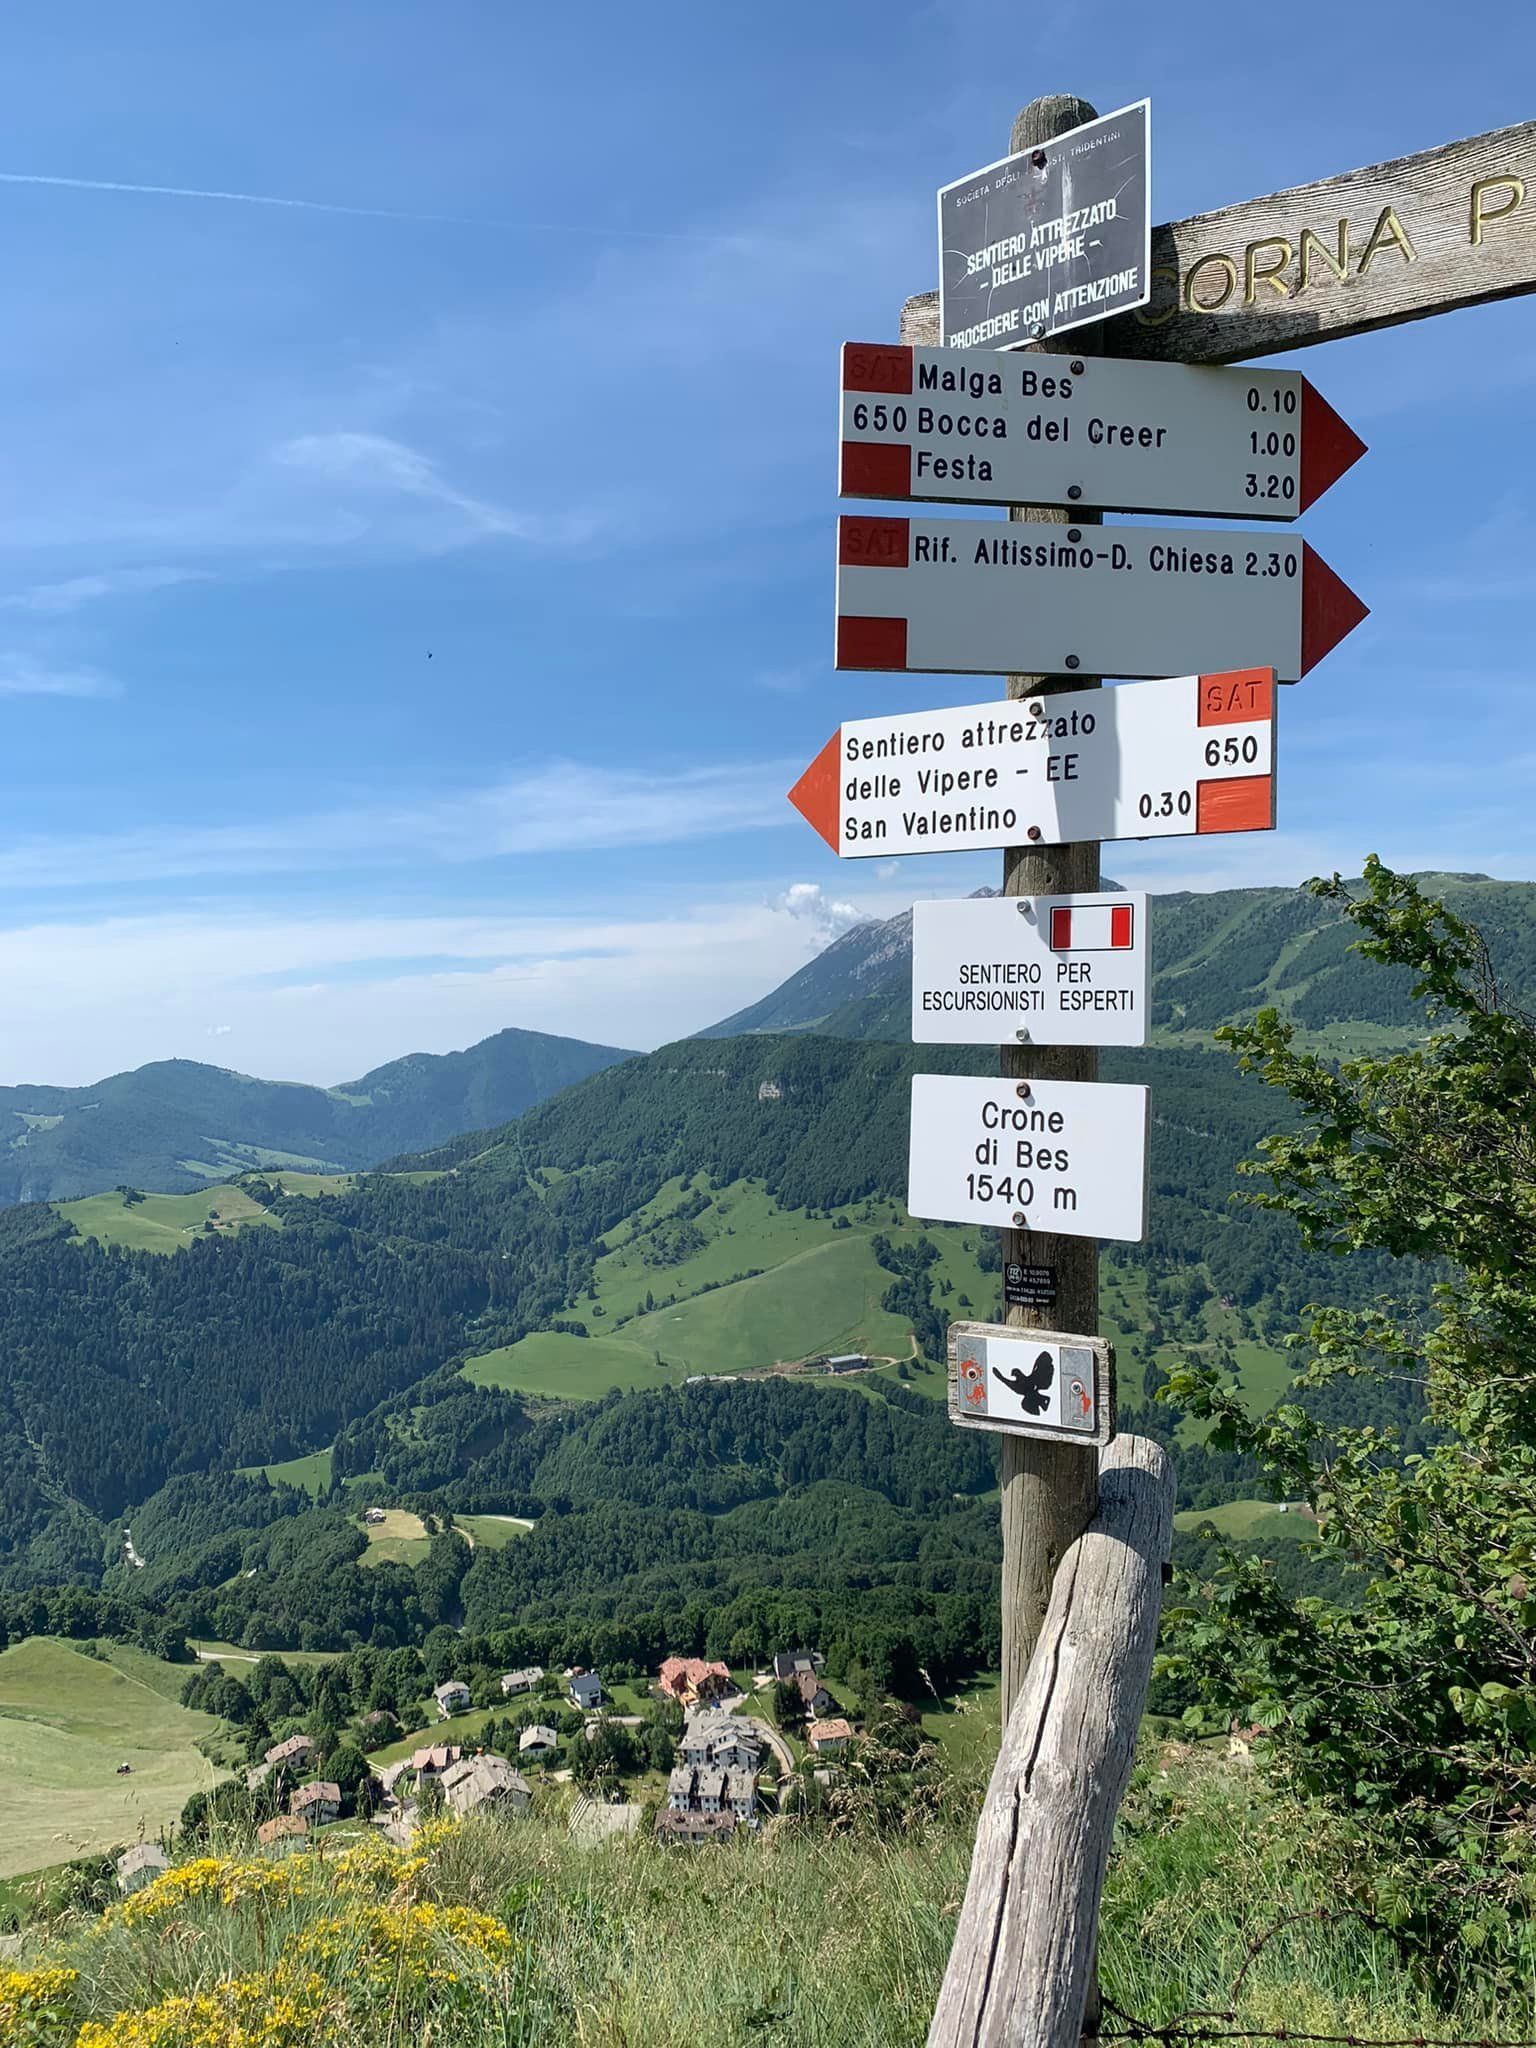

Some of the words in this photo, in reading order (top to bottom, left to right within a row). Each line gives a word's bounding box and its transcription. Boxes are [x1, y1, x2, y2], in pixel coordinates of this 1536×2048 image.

[1070, 129, 1121, 157] TRIDENTINI
[1470, 174, 1526, 247] P
[967, 231, 1026, 275] SENTIERO
[1030, 198, 1117, 248] ATTREZZATO
[992, 254, 1032, 289] DELLE
[1036, 234, 1085, 271] VIPERE
[950, 309, 1019, 349] PROCEDERE
[1023, 299, 1050, 325] CON
[1054, 267, 1138, 315] ATTENZIONE
[850, 353, 904, 383] SAT
[918, 363, 1003, 399] Malga
[1022, 370, 1073, 399] Bes
[1247, 388, 1297, 414] 0.10
[853, 403, 907, 432] 650
[918, 407, 1007, 439] Bocca
[1027, 415, 1068, 442] del
[1087, 418, 1167, 448] Creer
[1250, 431, 1295, 456] 1.00
[917, 451, 993, 481] Festa
[1245, 473, 1295, 499] 3.20
[847, 527, 899, 555] SAT
[915, 535, 957, 563] Rif.
[1150, 545, 1234, 574] Chiesa
[1245, 551, 1297, 578] 2.30
[1208, 681, 1263, 713] SAT
[846, 732, 945, 761] Sentiero
[962, 709, 1096, 748] attrezzato
[1205, 735, 1258, 767] 650
[846, 774, 901, 801] delle
[917, 767, 998, 796] Vipere
[1046, 753, 1080, 782] EE
[846, 817, 887, 841] San
[903, 806, 1017, 837] Valentino
[1139, 790, 1192, 818] 0.30
[959, 963, 1042, 984] SENTIERO
[1057, 962, 1092, 983] PER
[922, 990, 1045, 1011] ESCURSIONISTI
[1060, 990, 1134, 1011] ESPERTI
[982, 1101, 1064, 1133] Crone
[975, 1137, 998, 1166] di
[1016, 1140, 1069, 1172] Bes
[966, 1173, 1034, 1206] 1540
[1054, 1186, 1077, 1211] m
